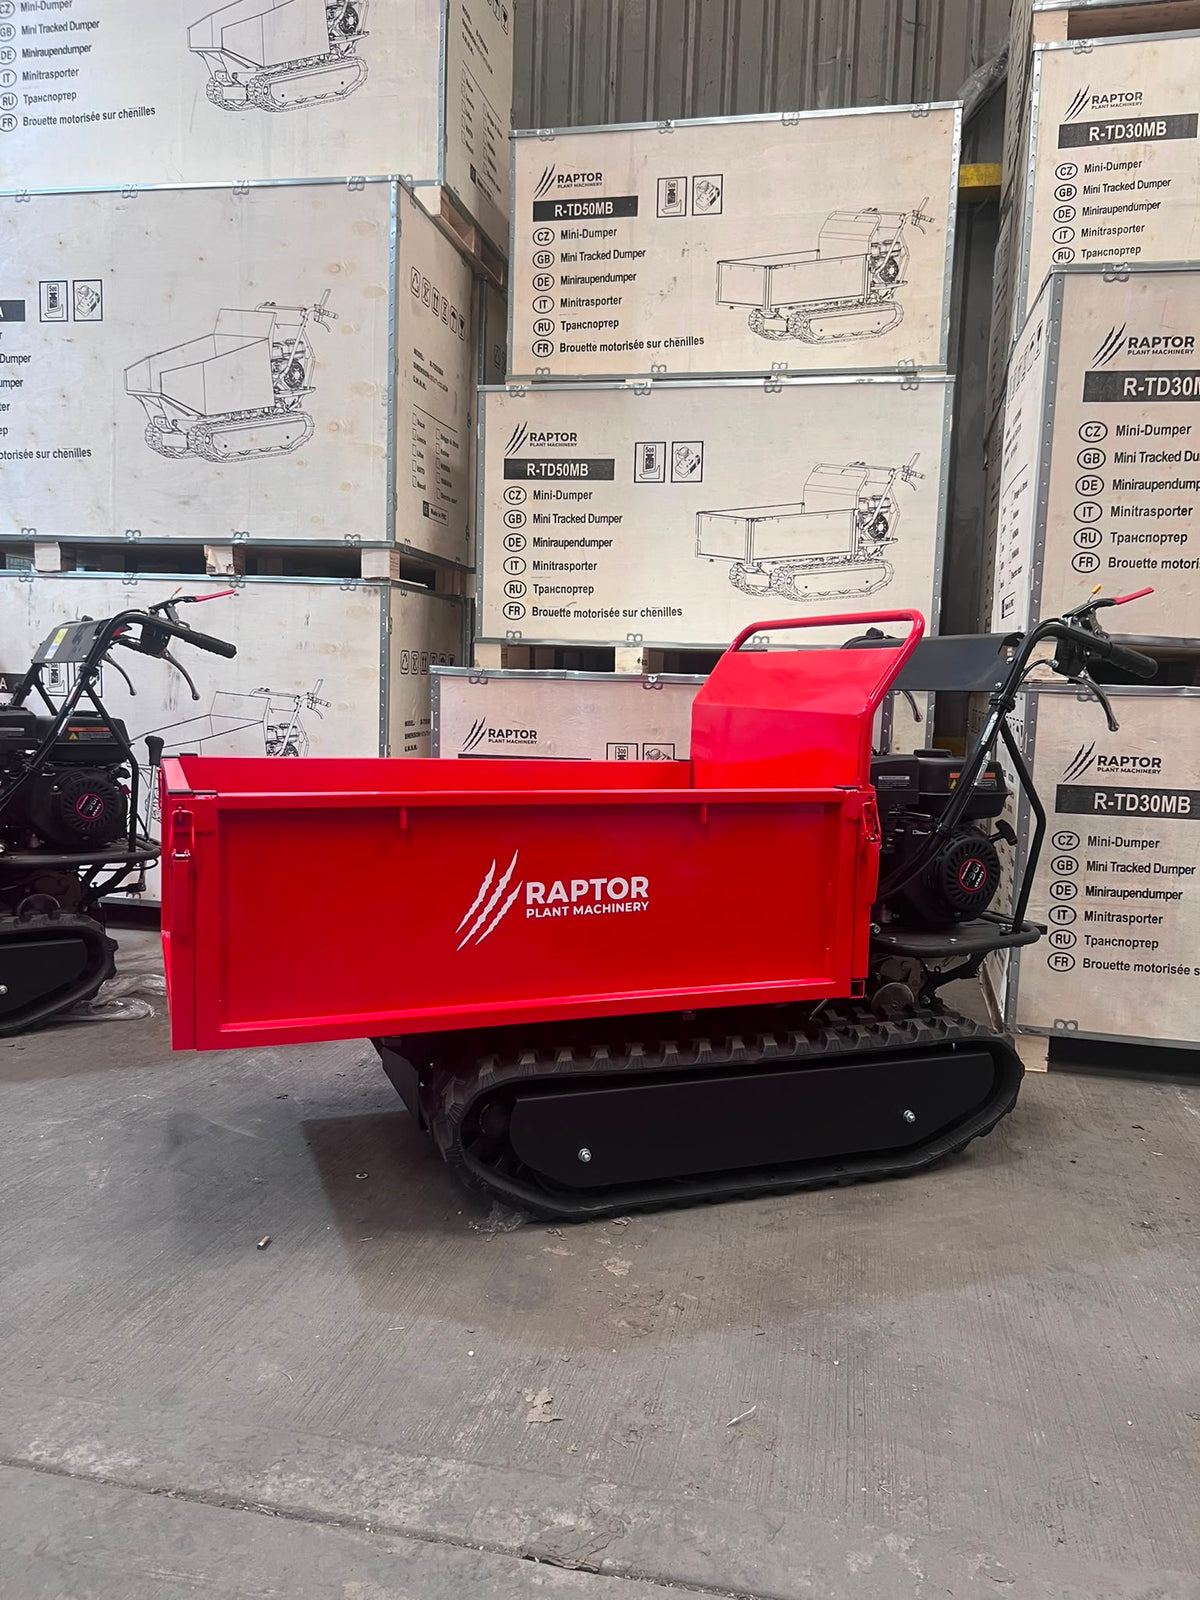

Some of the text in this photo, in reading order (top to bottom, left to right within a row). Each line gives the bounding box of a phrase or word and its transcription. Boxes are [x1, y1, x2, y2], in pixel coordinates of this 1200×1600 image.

[21, 0, 72, 12] Mini-Dumper
[0, 20, 100, 37] GB Mini Tracked Dumper
[1, 45, 92, 60] DE Miniraupendumper
[3, 68, 79, 83] IT Minitrasporter
[3, 91, 77, 106] RU Транспортер
[1091, 91, 1143, 105] RAPTOR
[1110, 101, 1143, 109] MACHINERY
[3, 106, 156, 127] FR Brouette motorisée sur chenilles
[1089, 121, 1167, 141] R-TD30MB
[1060, 160, 1142, 176] CZ Mini-Dumper
[557, 172, 602, 183] RAPTOR
[1059, 178, 1172, 197] GB Mini Tracked Dumper
[554, 202, 614, 217] R-TD50MB
[1058, 201, 1161, 219] DE Miniraupendumper
[537, 227, 618, 242] CZ Mini-Dumper
[1059, 224, 1145, 239] IT Minitrasporter
[537, 249, 647, 264] GB Mini Tracked Dumper
[1057, 246, 1142, 260] RU Транспортер
[537, 273, 637, 287] DE Miniraupendumper
[539, 296, 622, 309] IT Minitrasporter
[538, 319, 619, 332] RU Транспортер
[537, 336, 705, 354] FR Brouette motorisée sur chenilles
[1127, 336, 1195, 349] RAPTOR
[529, 432, 577, 443] RAPTOR
[1085, 424, 1192, 438] CZ Mini-Dumper
[36, 449, 50, 459] sur
[52, 447, 92, 459] chenilles
[1083, 453, 1100, 464] GB
[1114, 452, 1136, 464] Mini
[1139, 451, 1181, 463] Tracked
[526, 463, 589, 478] R-TD50MB
[1081, 480, 1098, 491] DE
[508, 490, 593, 503] CZ Mini-Dumper
[508, 513, 623, 525] GB Mini Tracked Dumper
[1082, 505, 1193, 519] IT Minitrasporter
[508, 536, 613, 550] DE Miniraupendumper
[1080, 532, 1188, 545] RU Транспортер
[510, 560, 598, 574] IT Minitrasporter
[1078, 557, 1200, 569] FR Brouette motori
[509, 583, 595, 597] RU Транспортер
[508, 606, 683, 618] FR Brouette motorisée sur chenilles
[488, 728, 537, 740] RAPTOR
[1097, 755, 1162, 769] RAPTOR
[1120, 767, 1162, 775] MACHINERY
[1094, 792, 1191, 815] R-TD30MB
[1058, 836, 1160, 849] CZ Mini-Dumper
[1056, 860, 1197, 877] GB Mini Tracked Dumper
[525, 876, 649, 905] RAPTOR
[1056, 884, 1183, 901] DE Miniraupendumper
[526, 901, 650, 919] PLANT MACHINERY
[1057, 910, 1164, 925] IT Minitrasporter
[1055, 934, 1159, 951] RU Транспортер
[1054, 956, 1069, 967] FR
[1082, 957, 1130, 971] Brouette
[1133, 963, 1190, 976] motorisée
